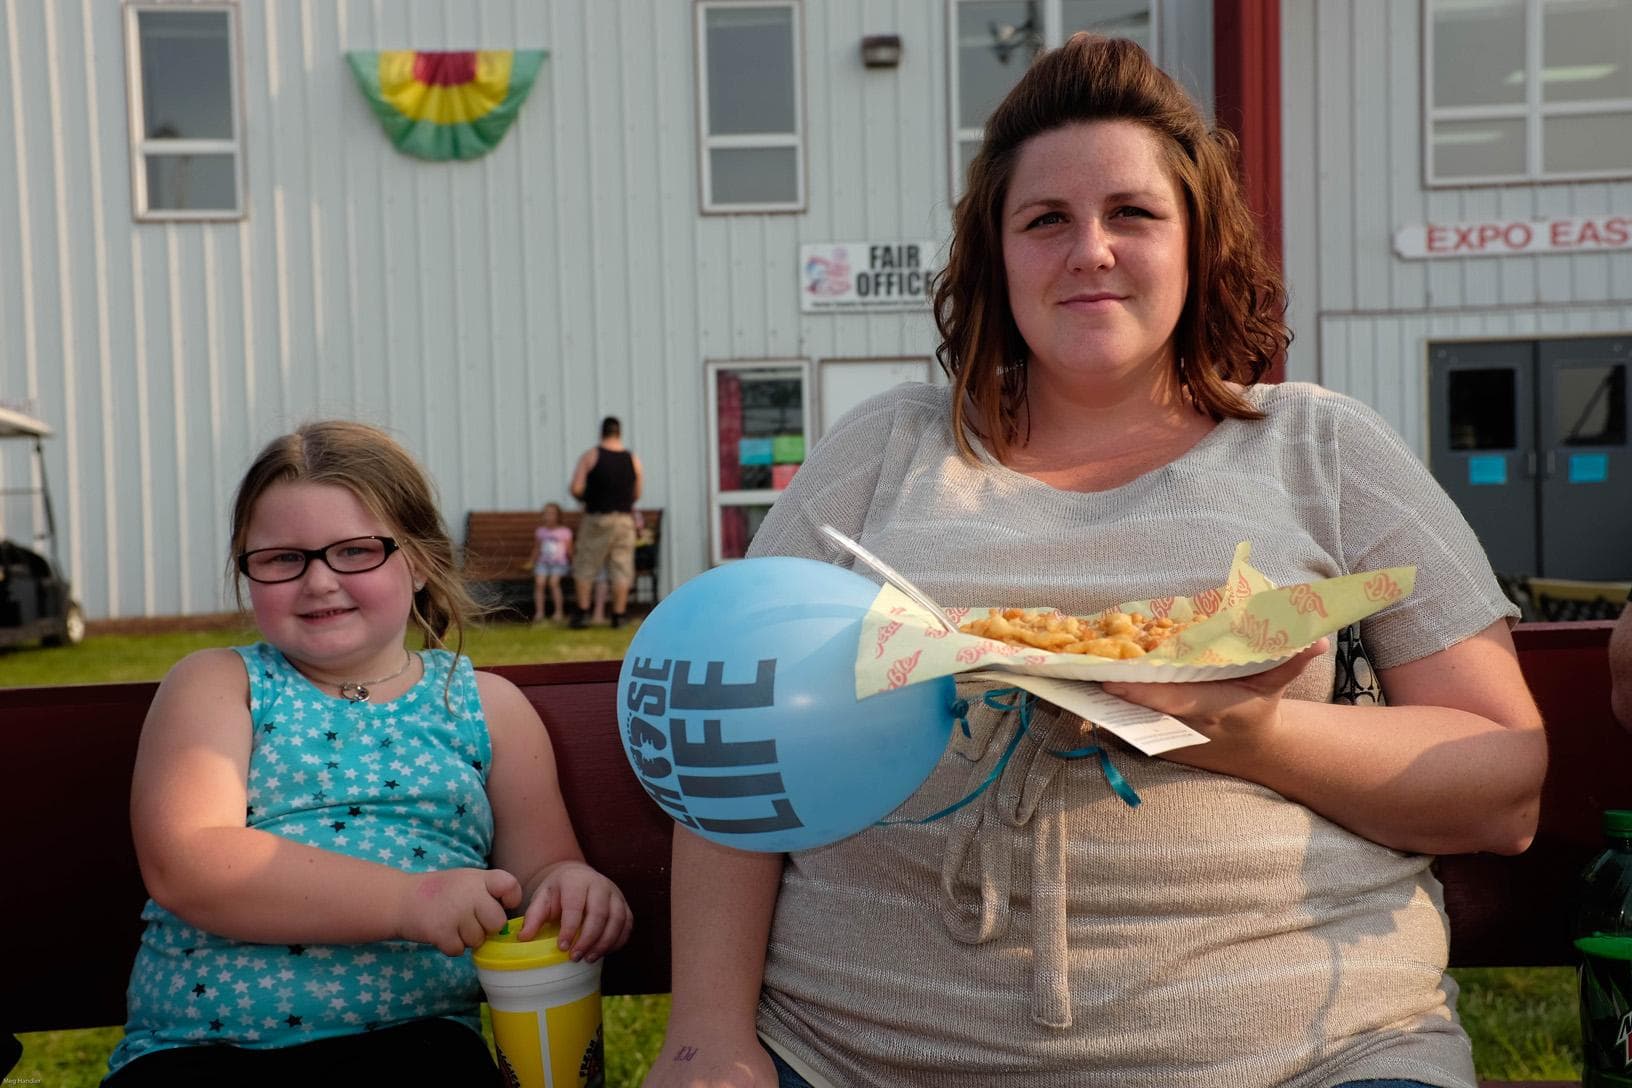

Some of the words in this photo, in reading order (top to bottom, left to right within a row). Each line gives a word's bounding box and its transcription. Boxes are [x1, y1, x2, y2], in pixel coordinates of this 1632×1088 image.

[1426, 223, 1533, 252] EXPO
[1550, 218, 1632, 247] EAS
[869, 245, 921, 269] FAIR
[669, 658, 805, 834] LIFE
